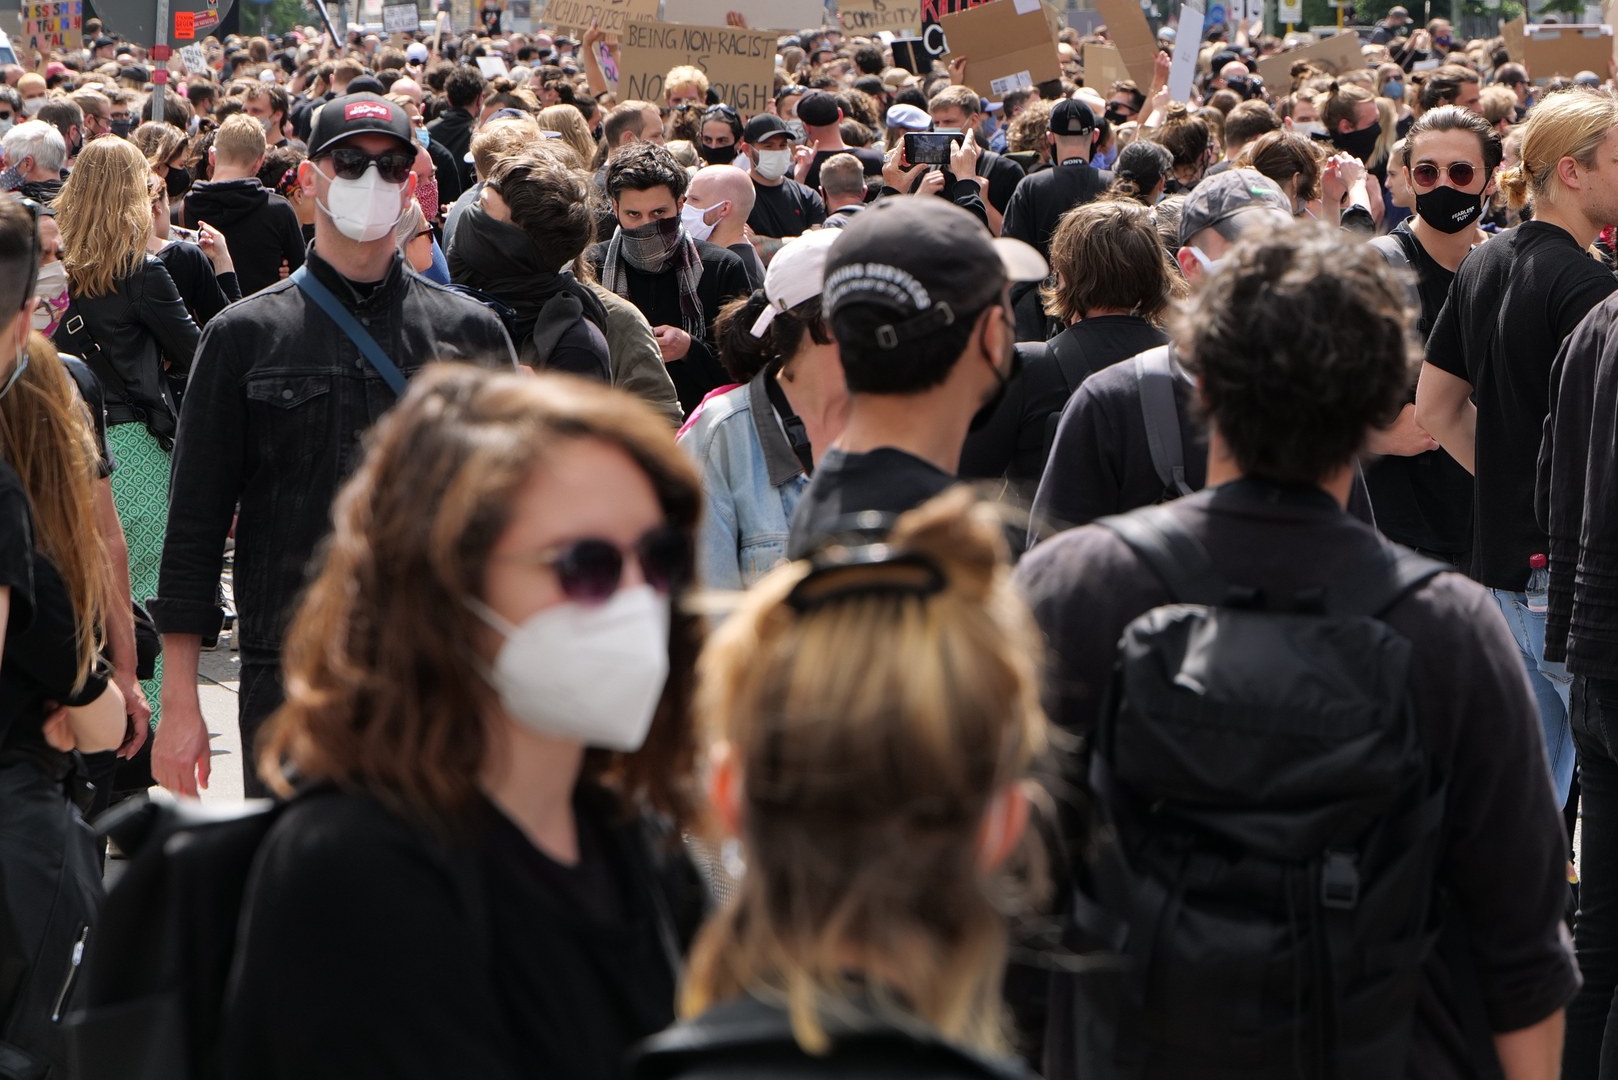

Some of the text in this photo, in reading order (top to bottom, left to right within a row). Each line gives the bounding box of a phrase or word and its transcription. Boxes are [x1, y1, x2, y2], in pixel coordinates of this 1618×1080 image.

[842, 8, 919, 30] COMPLICITY
[626, 24, 778, 59] BEING NON-RACIST
[686, 54, 711, 74] IS
[627, 73, 666, 101] NO
